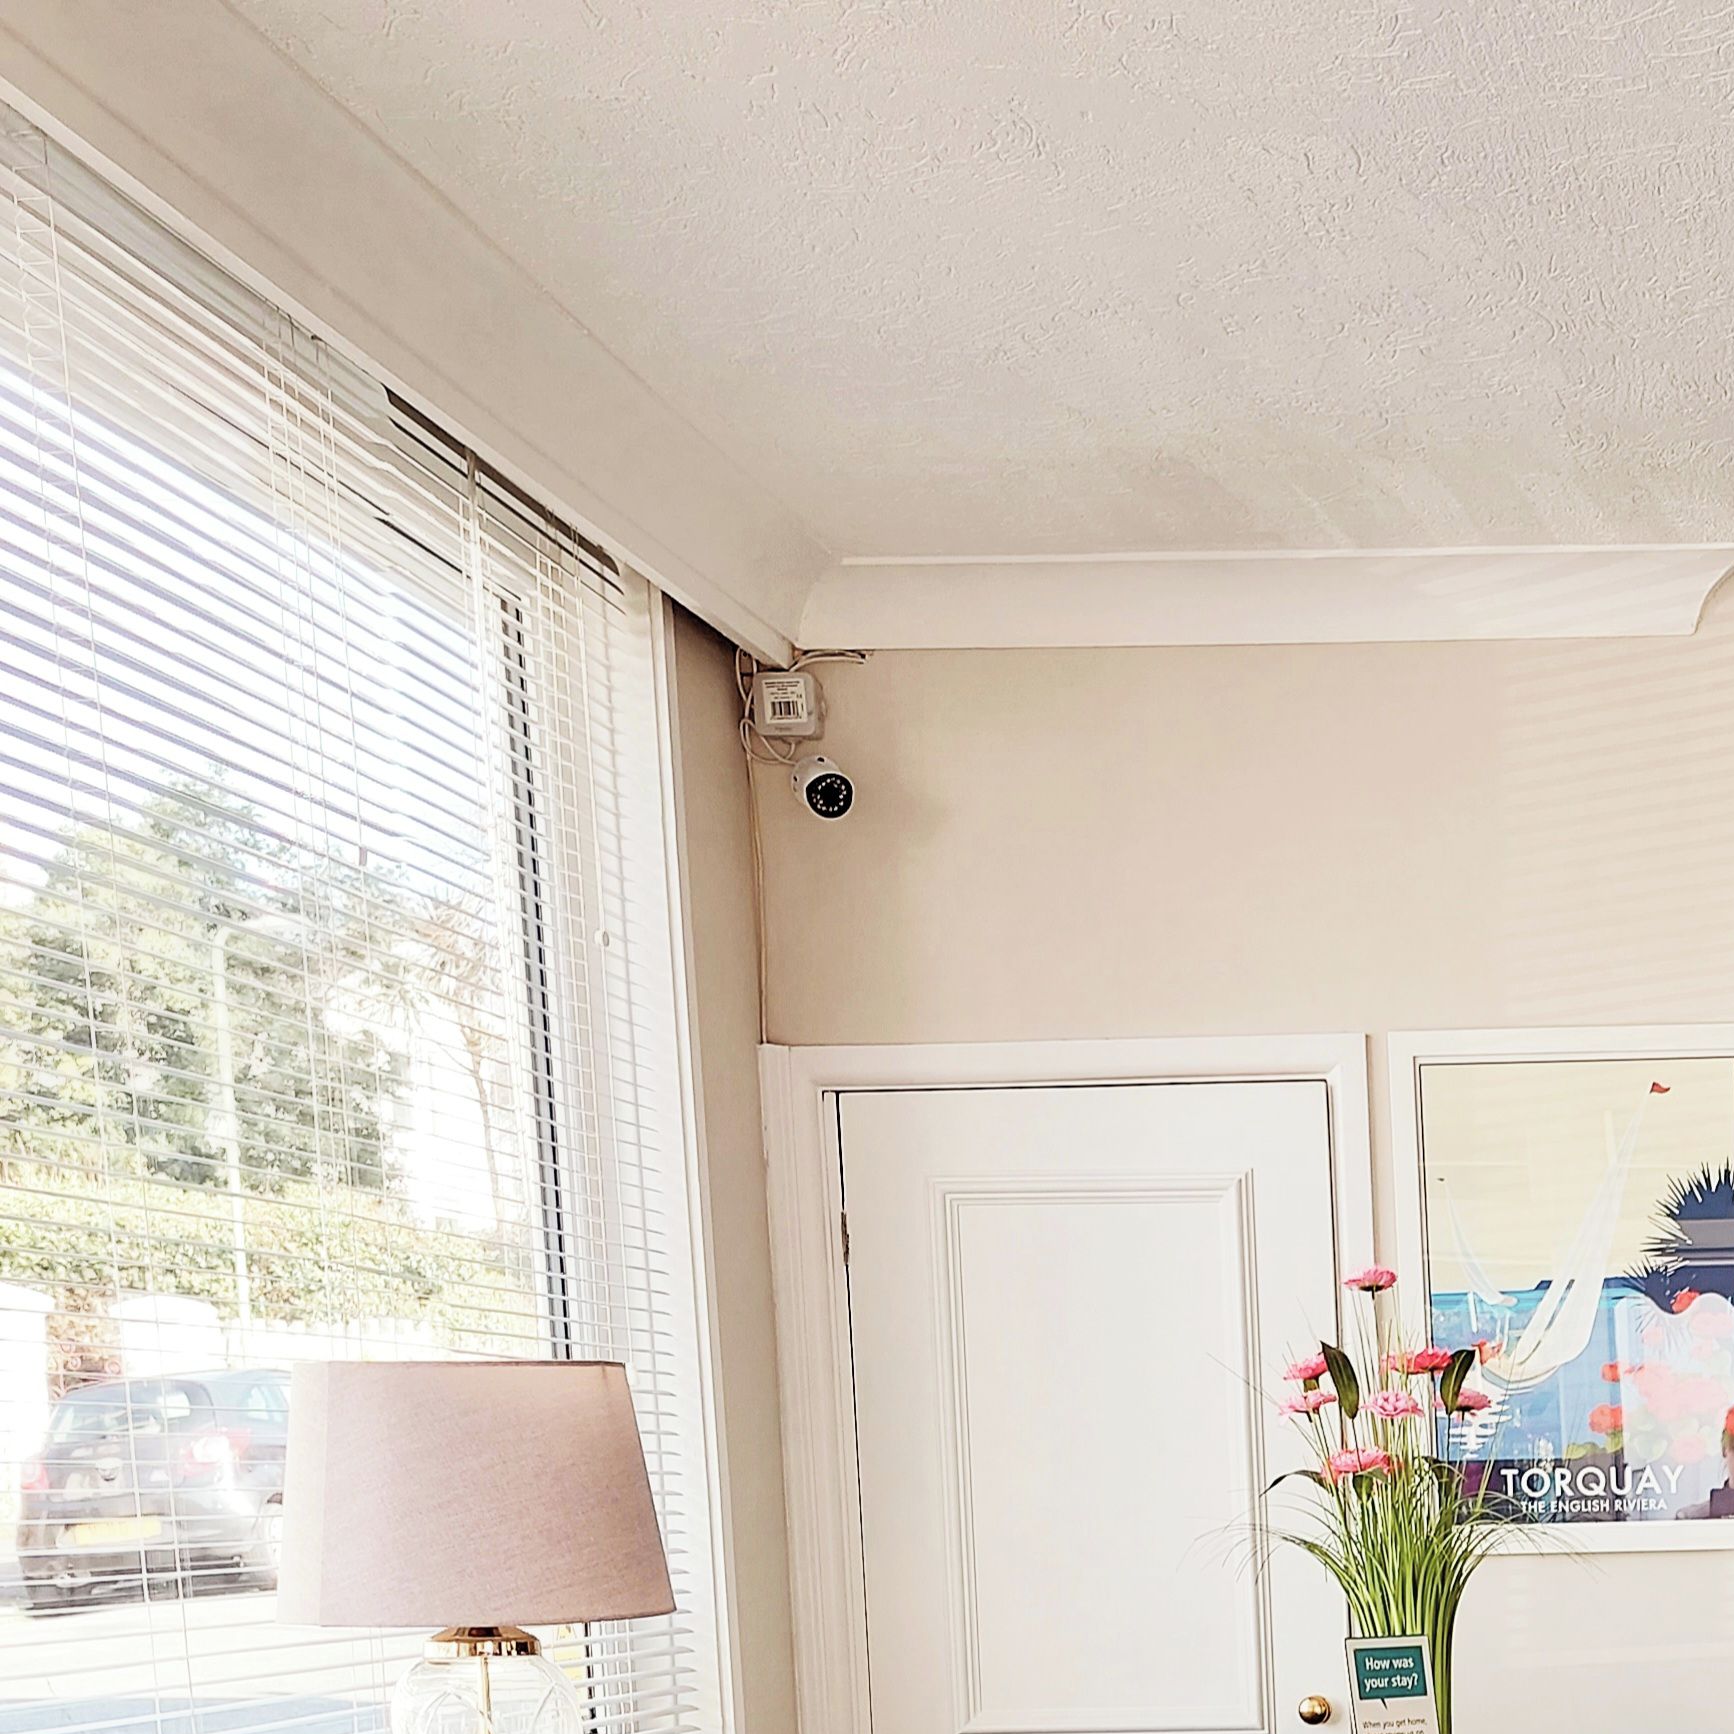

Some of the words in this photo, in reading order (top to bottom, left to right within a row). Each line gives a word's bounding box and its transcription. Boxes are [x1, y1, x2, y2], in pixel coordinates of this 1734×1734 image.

[1500, 1464, 1684, 1498] TORQUAY
[1521, 1500, 1546, 1513] THE
[1550, 1498, 1610, 1513] ENGLISH
[1614, 1498, 1668, 1511] RIVIERA
[1365, 1656, 1390, 1671] How
[1392, 1657, 1414, 1669] was
[1364, 1677, 1389, 1692] your
[1391, 1672, 1418, 1690] stay?
[1363, 1720, 1381, 1729] When
[1383, 1721, 1394, 1730] you
[1395, 1719, 1406, 1728] get
